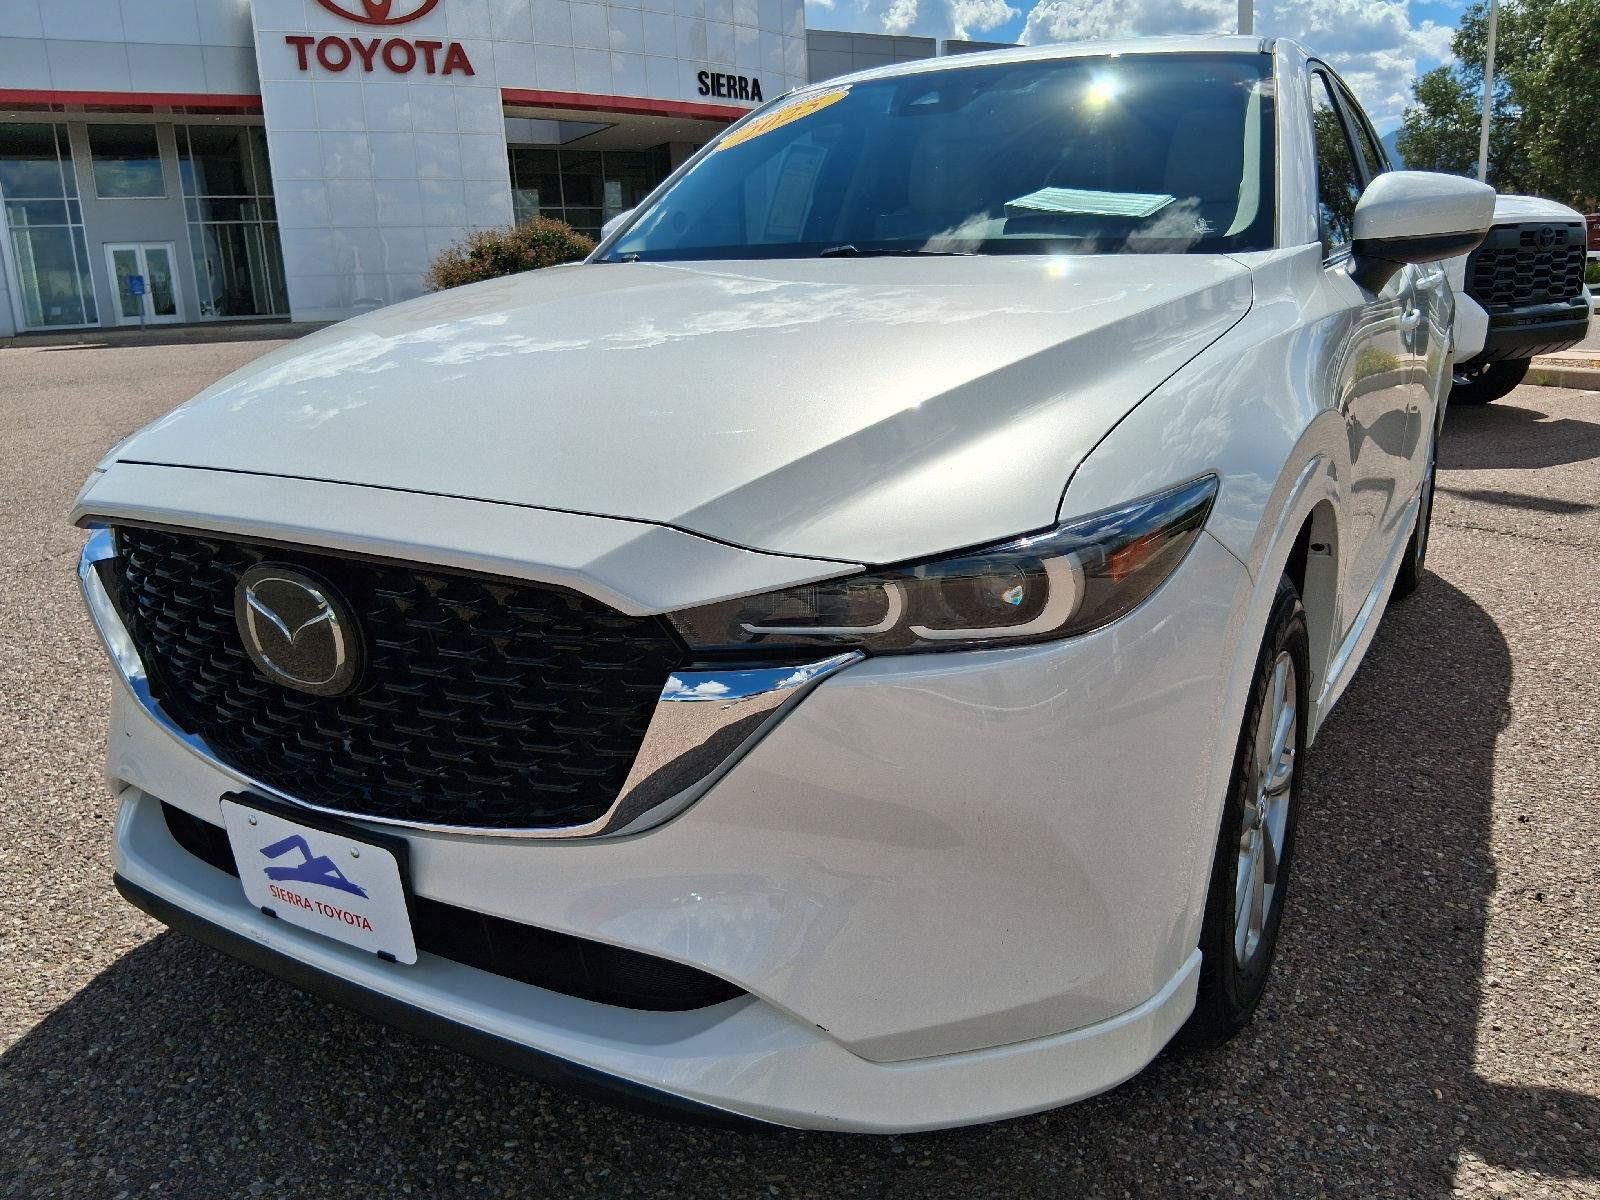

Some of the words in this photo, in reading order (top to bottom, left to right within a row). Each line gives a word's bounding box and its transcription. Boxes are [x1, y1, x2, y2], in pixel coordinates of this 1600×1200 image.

[285, 35, 475, 77] TOYOTA
[697, 70, 763, 103] SIERRA
[269, 884, 314, 912] SIERRA
[315, 901, 373, 932] TOYOTA
